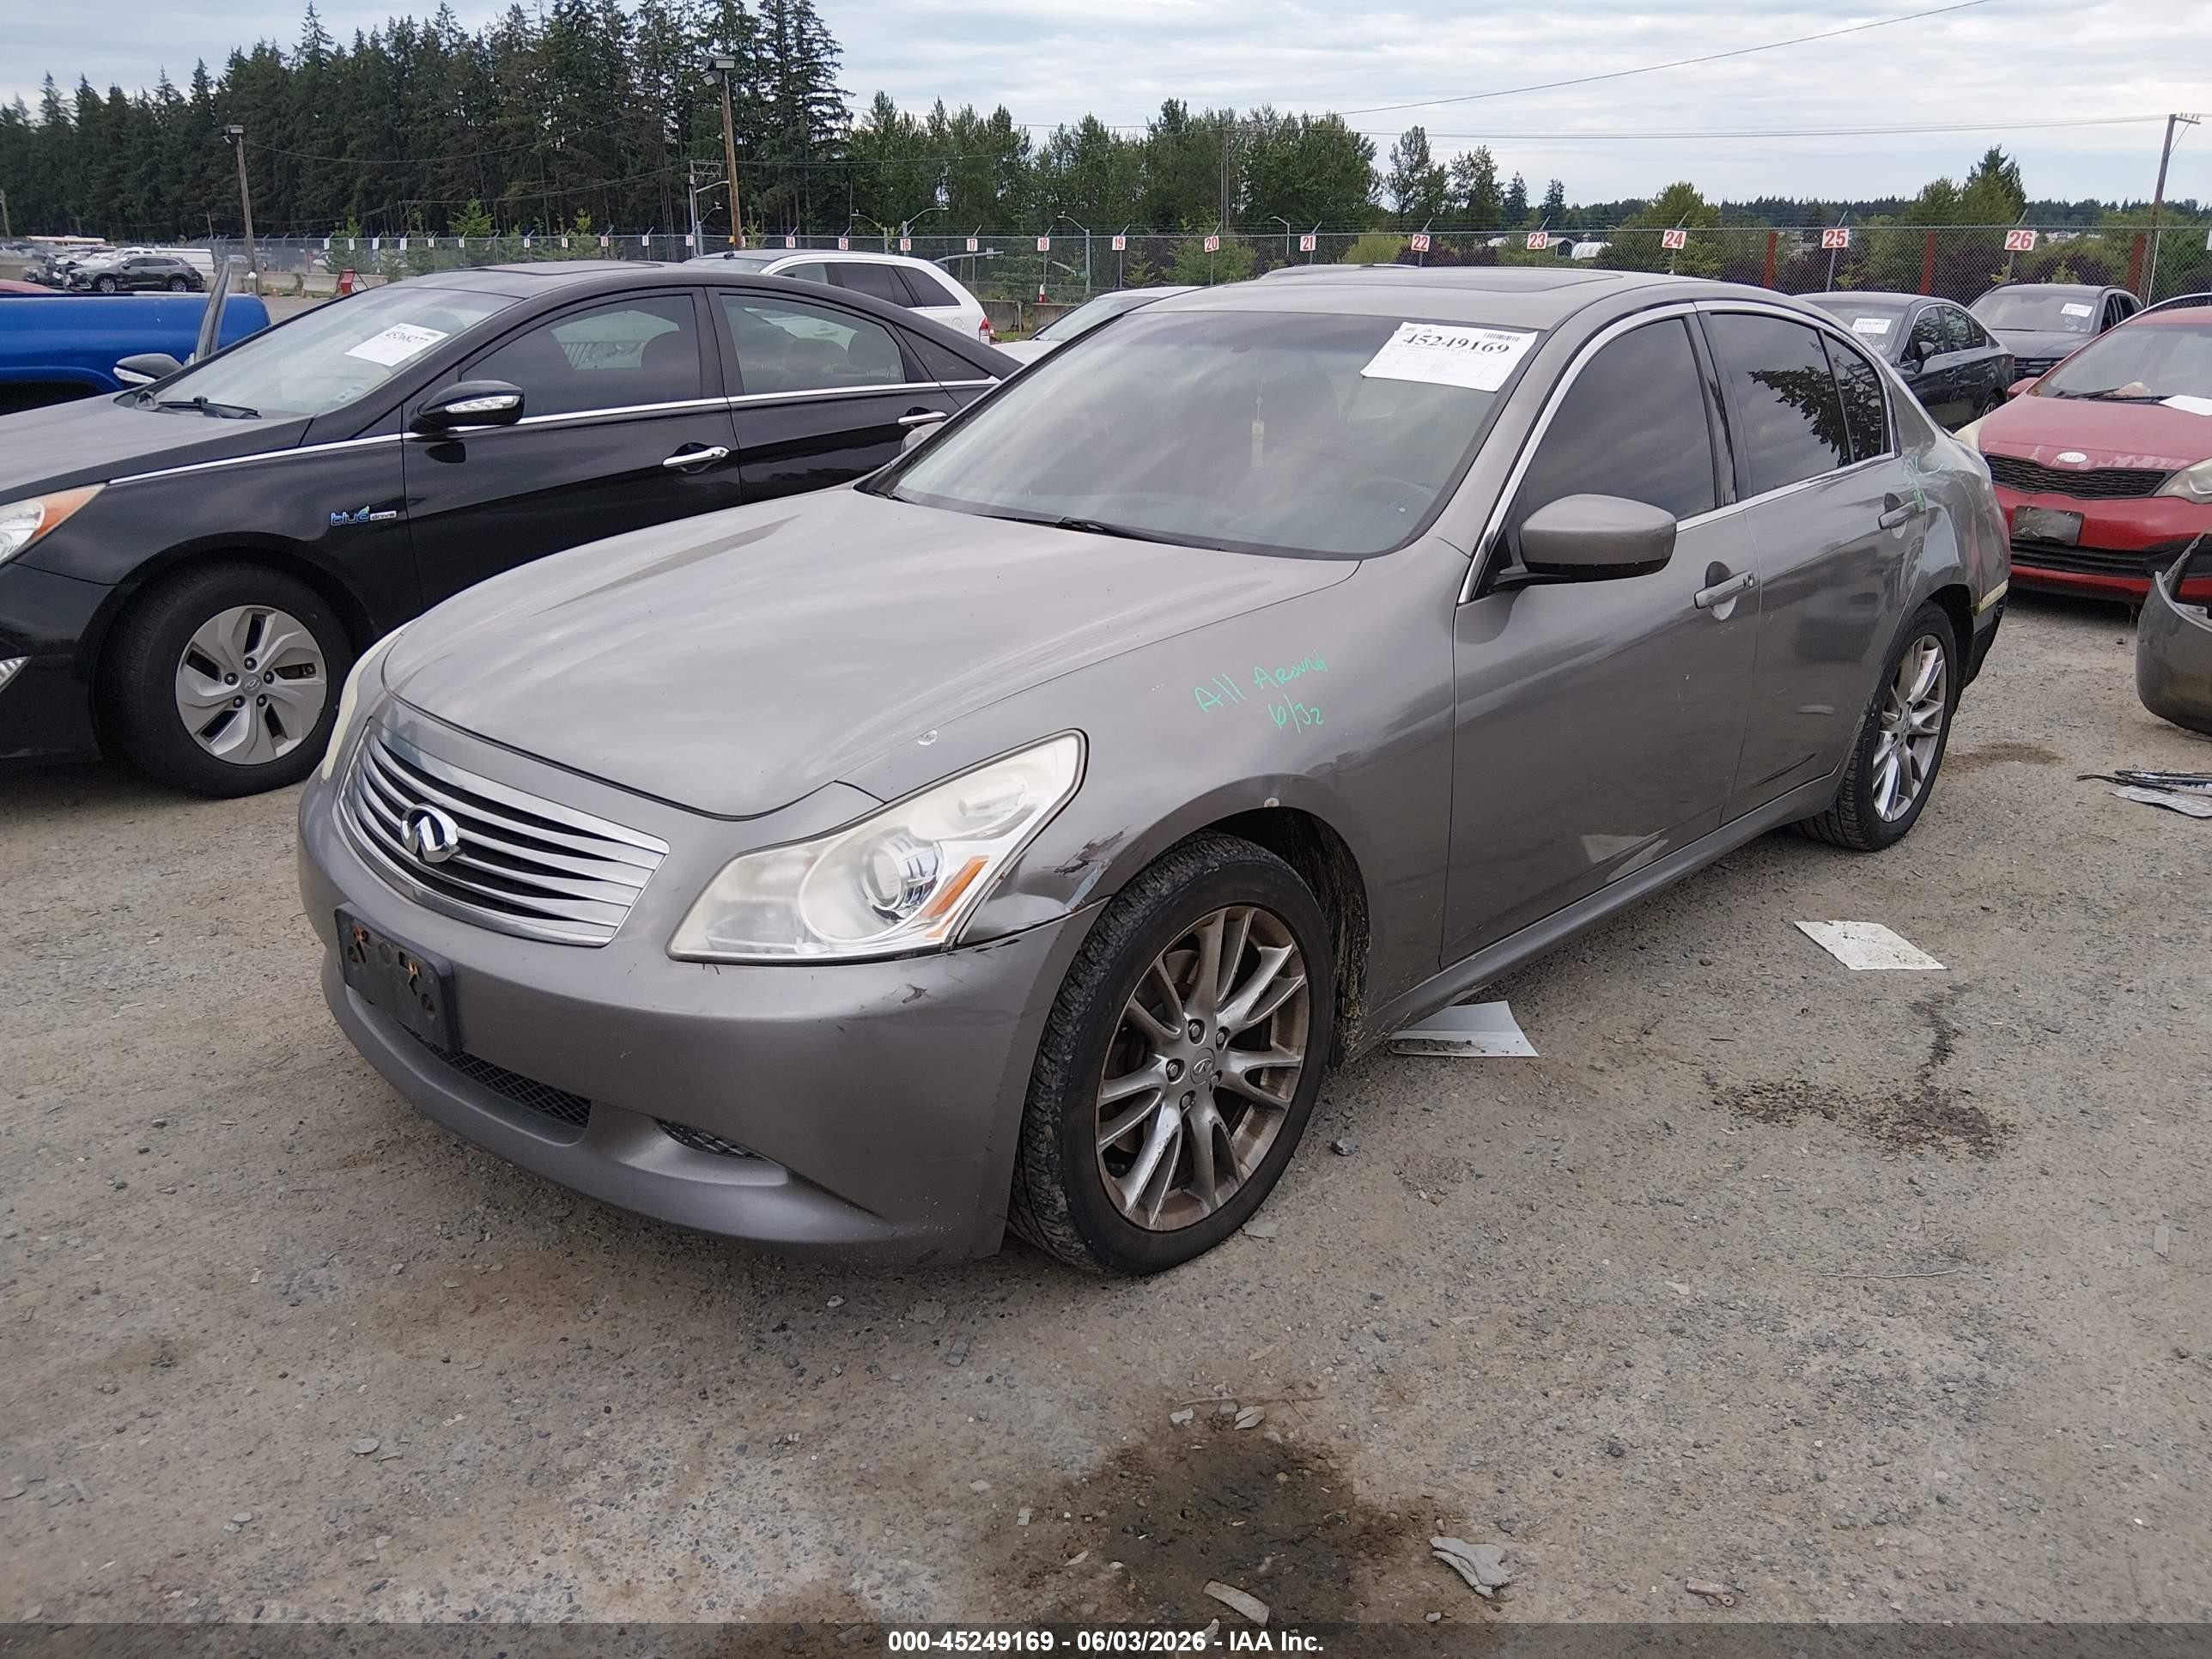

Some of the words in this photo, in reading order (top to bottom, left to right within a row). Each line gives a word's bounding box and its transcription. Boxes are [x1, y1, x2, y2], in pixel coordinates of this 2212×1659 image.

[839, 238, 848, 249] 15
[901, 240, 910, 250] 16
[968, 239, 977, 250] 17
[1039, 239, 1048, 250] 18
[1115, 237, 1124, 249] 19
[1204, 236, 1218, 251] 20
[1303, 236, 1314, 251] 21
[1413, 234, 1429, 252] 22
[1528, 233, 1547, 249] 23
[1664, 231, 1685, 249] 24
[1824, 229, 1846, 249] 25
[2008, 231, 2032, 251] 26
[1402, 332, 1510, 355] 45249169
[331, 508, 369, 526] blue
[1194, 673, 1248, 713] All
